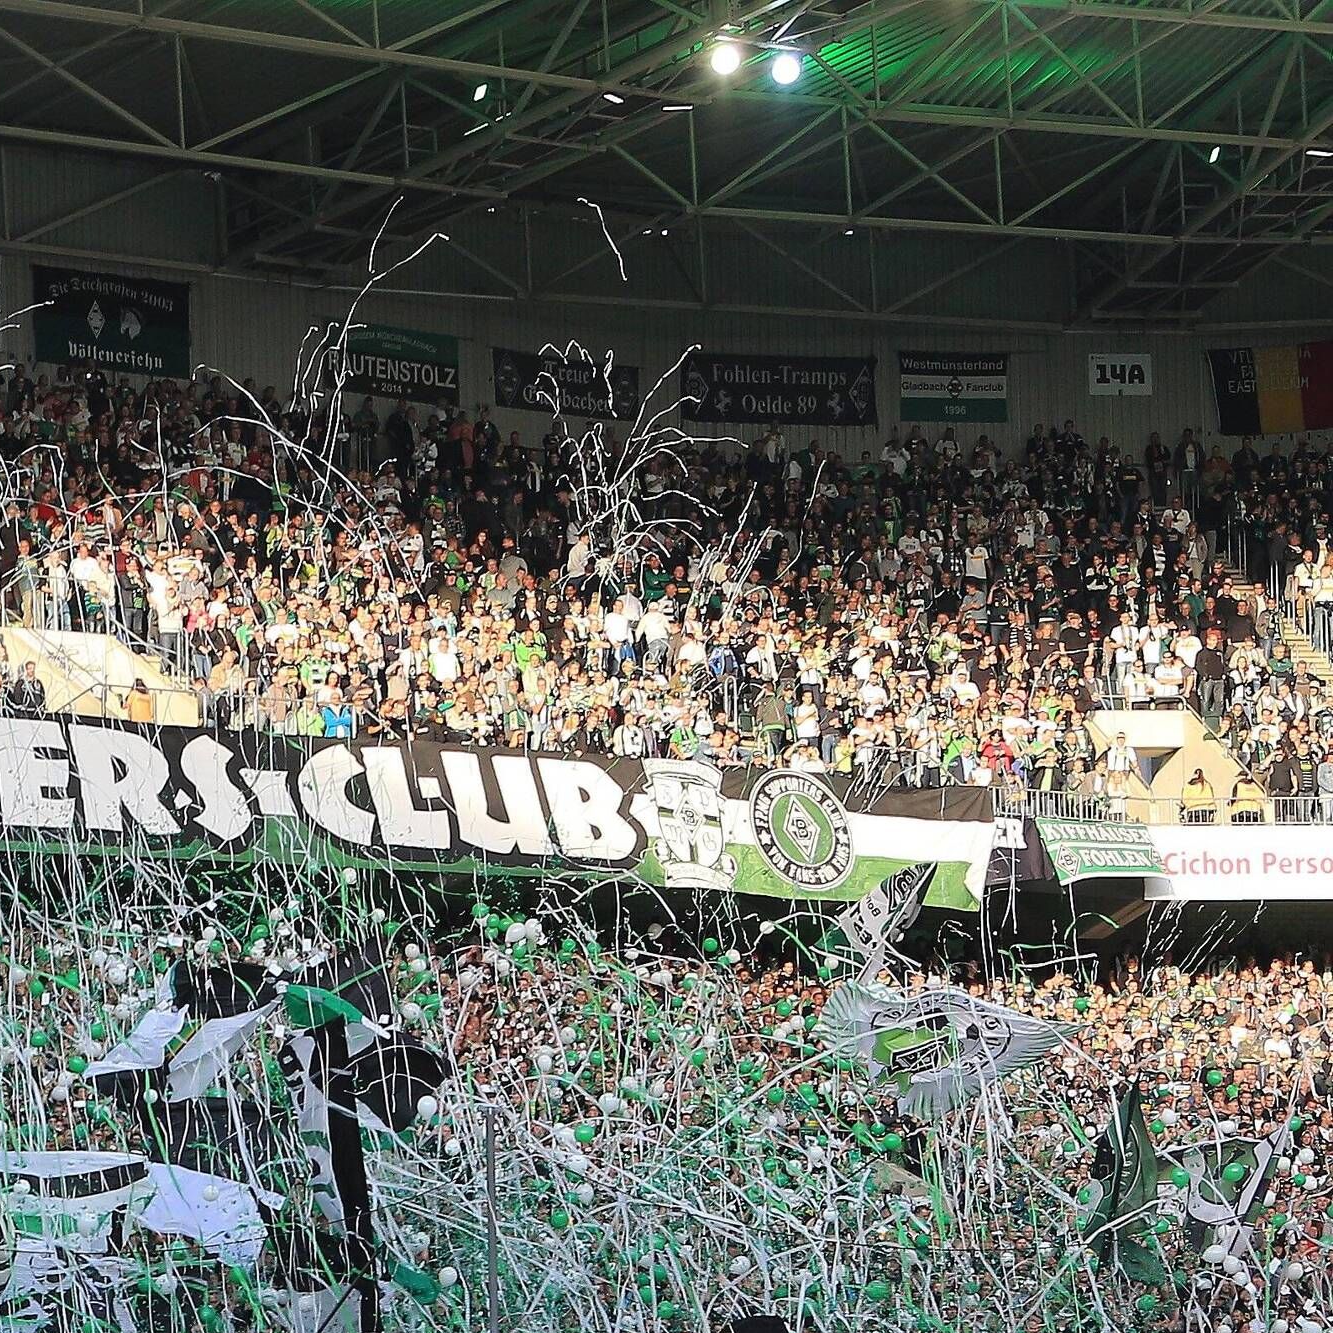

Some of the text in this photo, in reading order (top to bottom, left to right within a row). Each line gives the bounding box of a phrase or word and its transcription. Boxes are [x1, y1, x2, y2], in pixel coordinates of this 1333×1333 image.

[900, 356, 1005, 374] Westmünsterland
[1095, 363, 1145, 385] 14A
[711, 362, 848, 391] Fohlen-Tramps
[965, 381, 1005, 393] Fanclub
[380, 382, 403, 394] 2014
[741, 394, 818, 416] Oelde 89
[1080, 846, 1152, 868] FOHLEN
[1164, 851, 1333, 875] Cichon Perso
